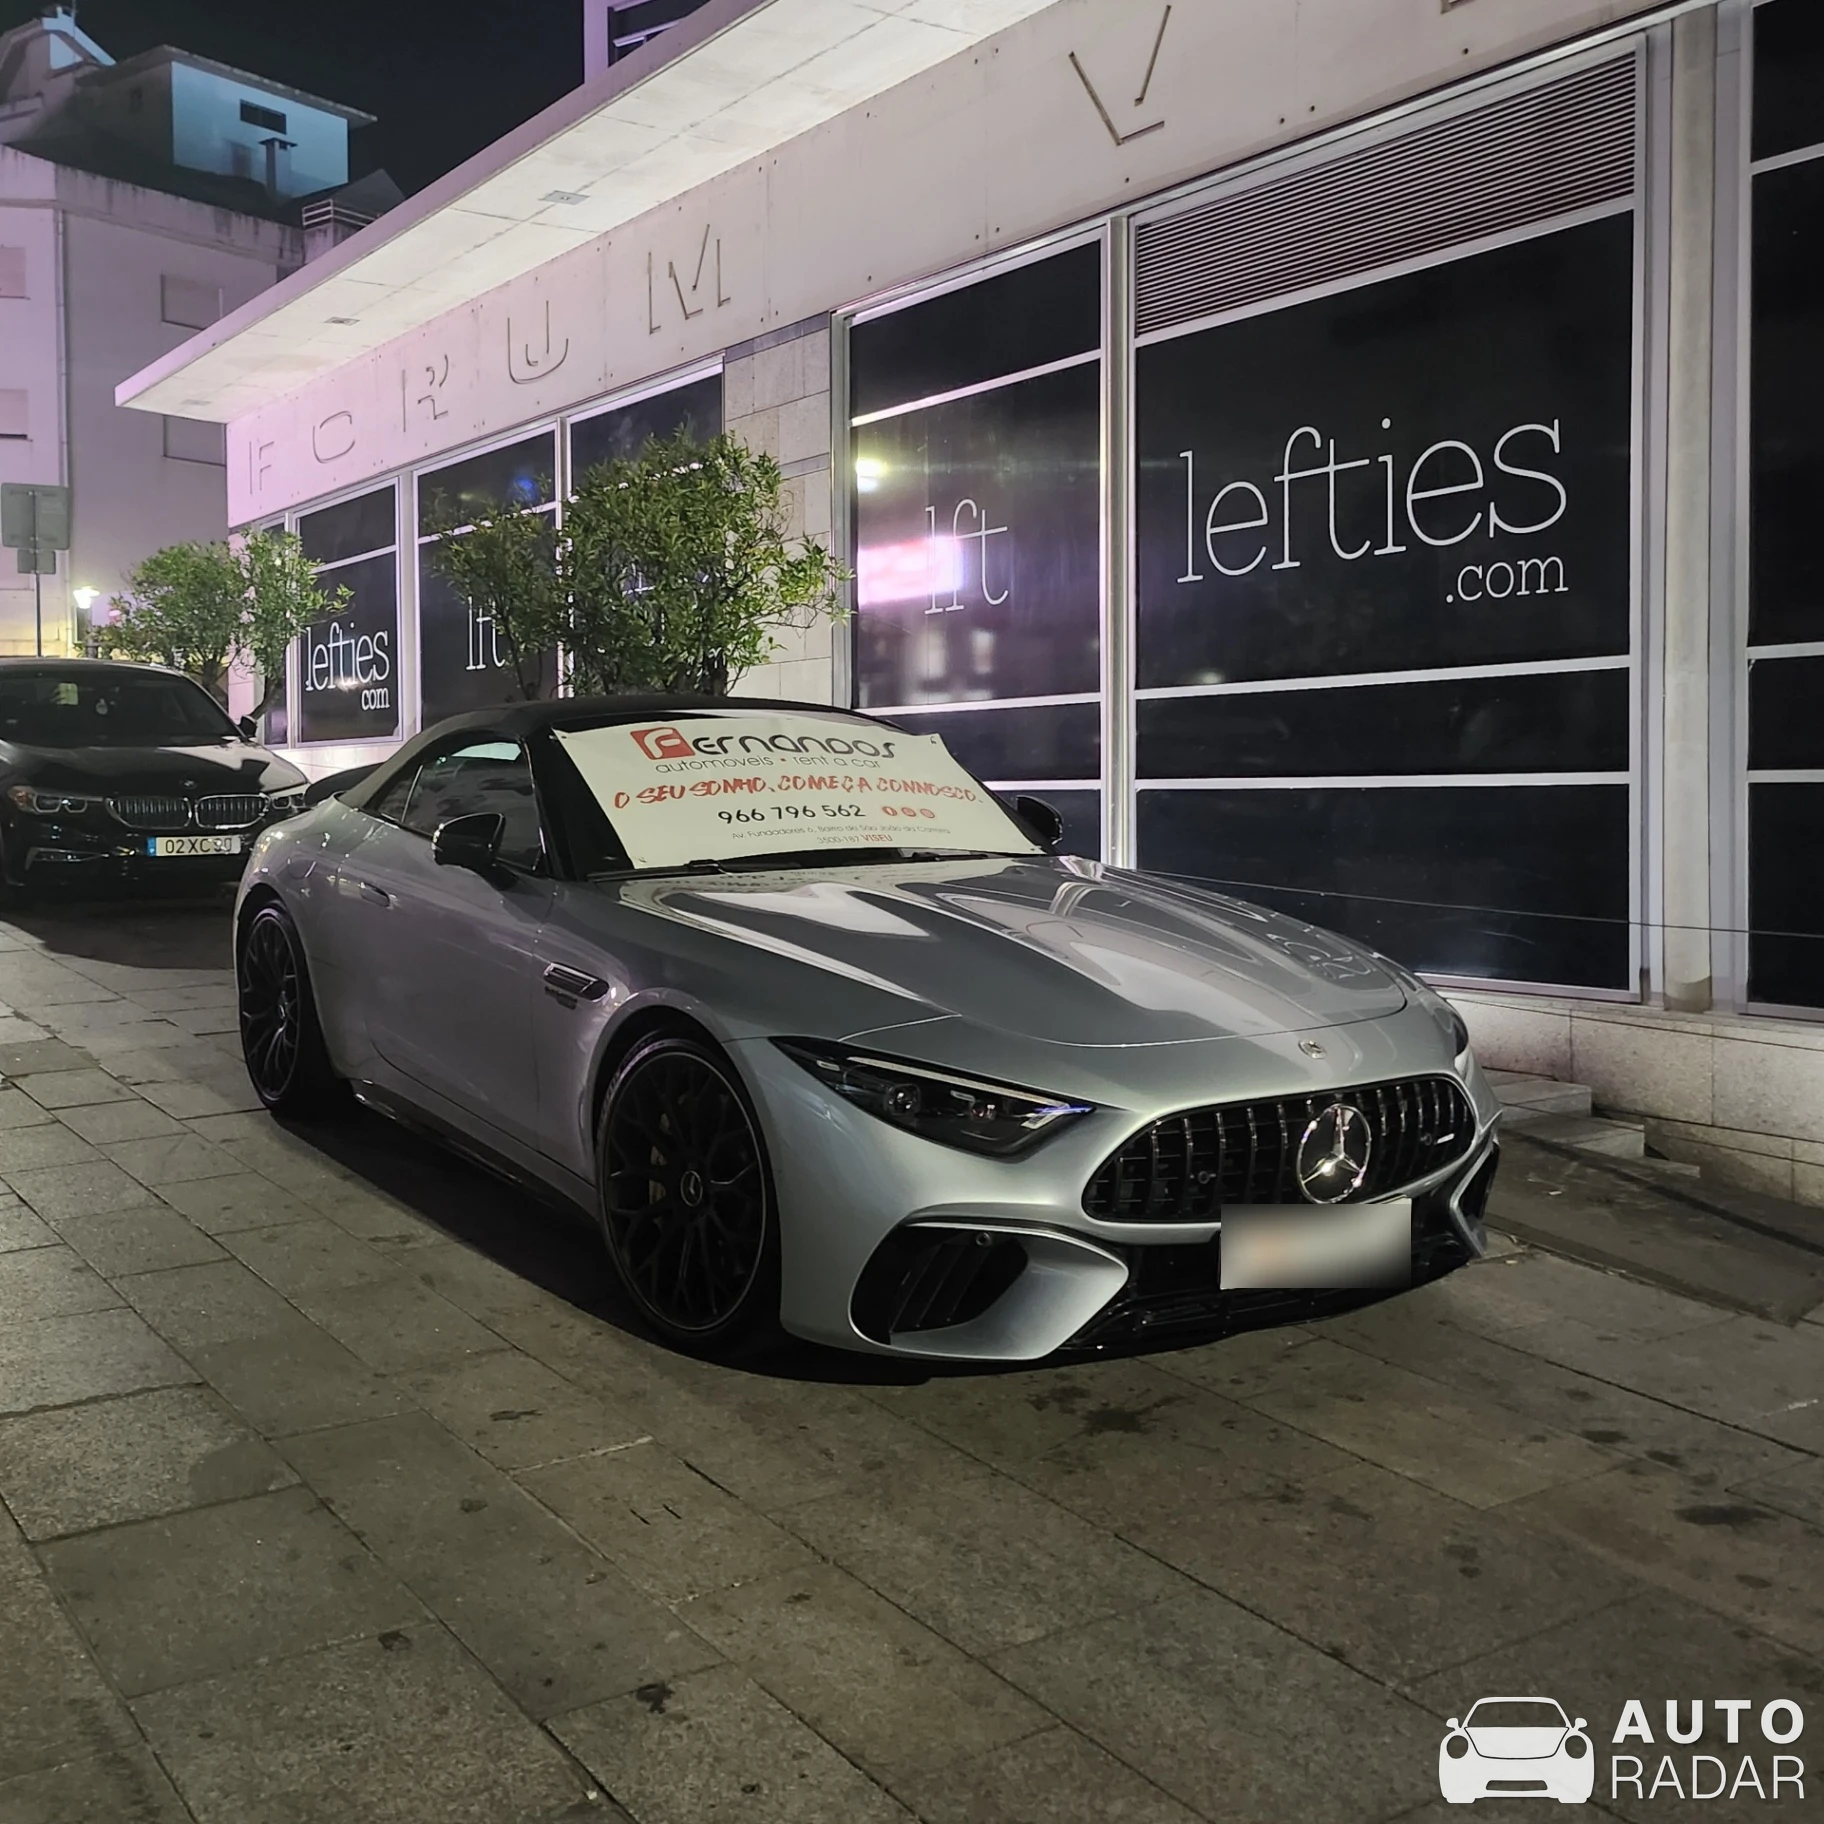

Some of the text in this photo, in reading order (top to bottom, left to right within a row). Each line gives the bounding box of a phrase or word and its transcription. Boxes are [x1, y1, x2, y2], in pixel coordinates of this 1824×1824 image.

[248, 223, 732, 496] FORUM
[1178, 417, 1567, 583] lefties
[925, 499, 1008, 614] lft
[1446, 555, 1569, 603] .com
[305, 622, 390, 691] lefties
[793, 755, 829, 766] rent
[833, 757, 848, 767] a
[851, 759, 881, 769] car
[614, 792, 630, 809] O
[636, 784, 686, 804] SEU
[717, 804, 866, 824] 966 796 562
[860, 834, 893, 842] VISEU
